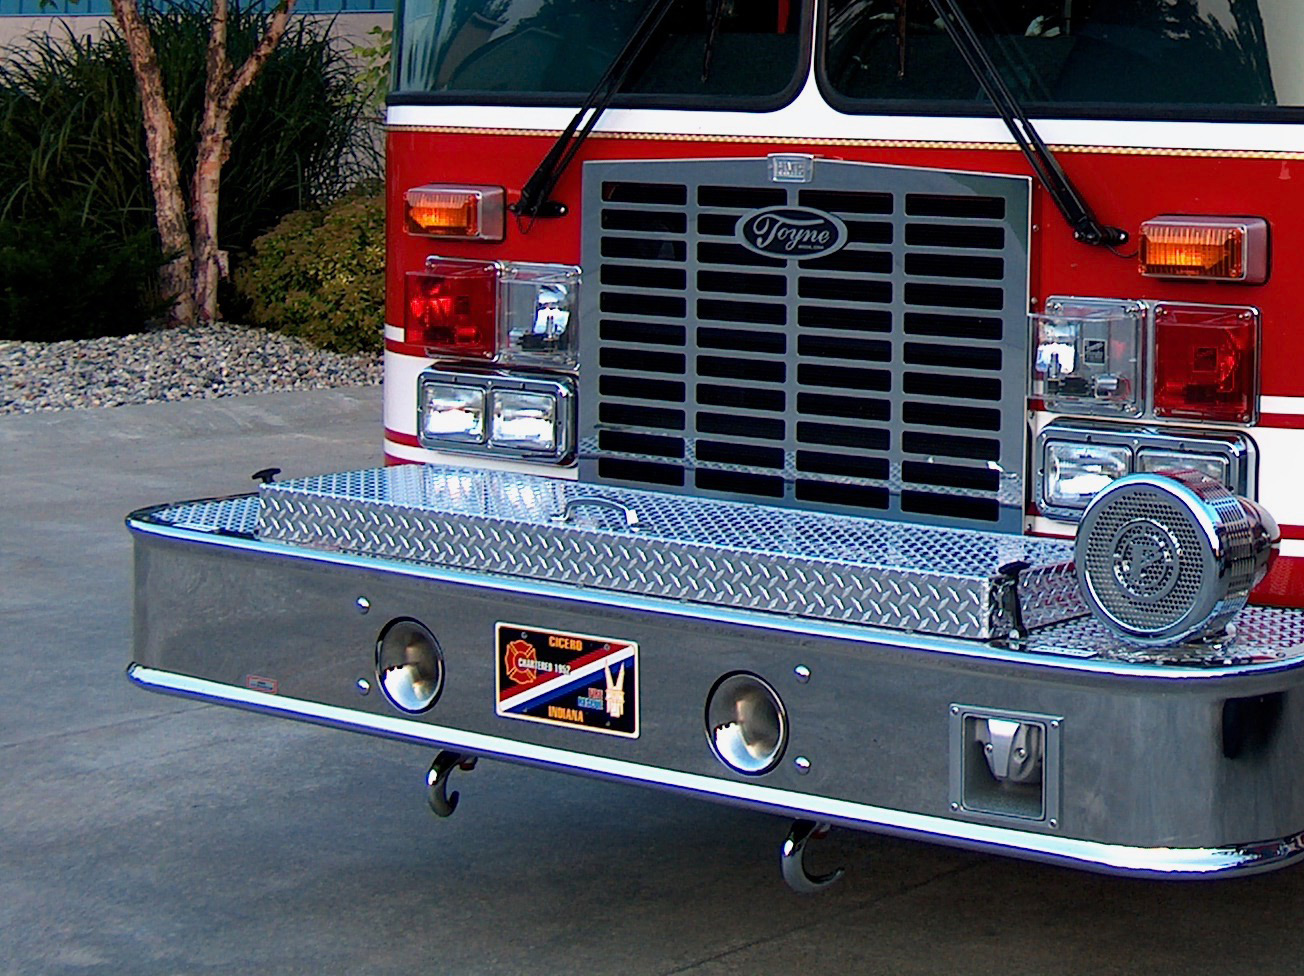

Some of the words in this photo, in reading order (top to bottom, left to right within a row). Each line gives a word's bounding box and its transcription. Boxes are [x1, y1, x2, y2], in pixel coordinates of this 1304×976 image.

[753, 214, 830, 251] Toyne
[548, 636, 583, 651] CICERO
[548, 705, 584, 722] INDIANA
